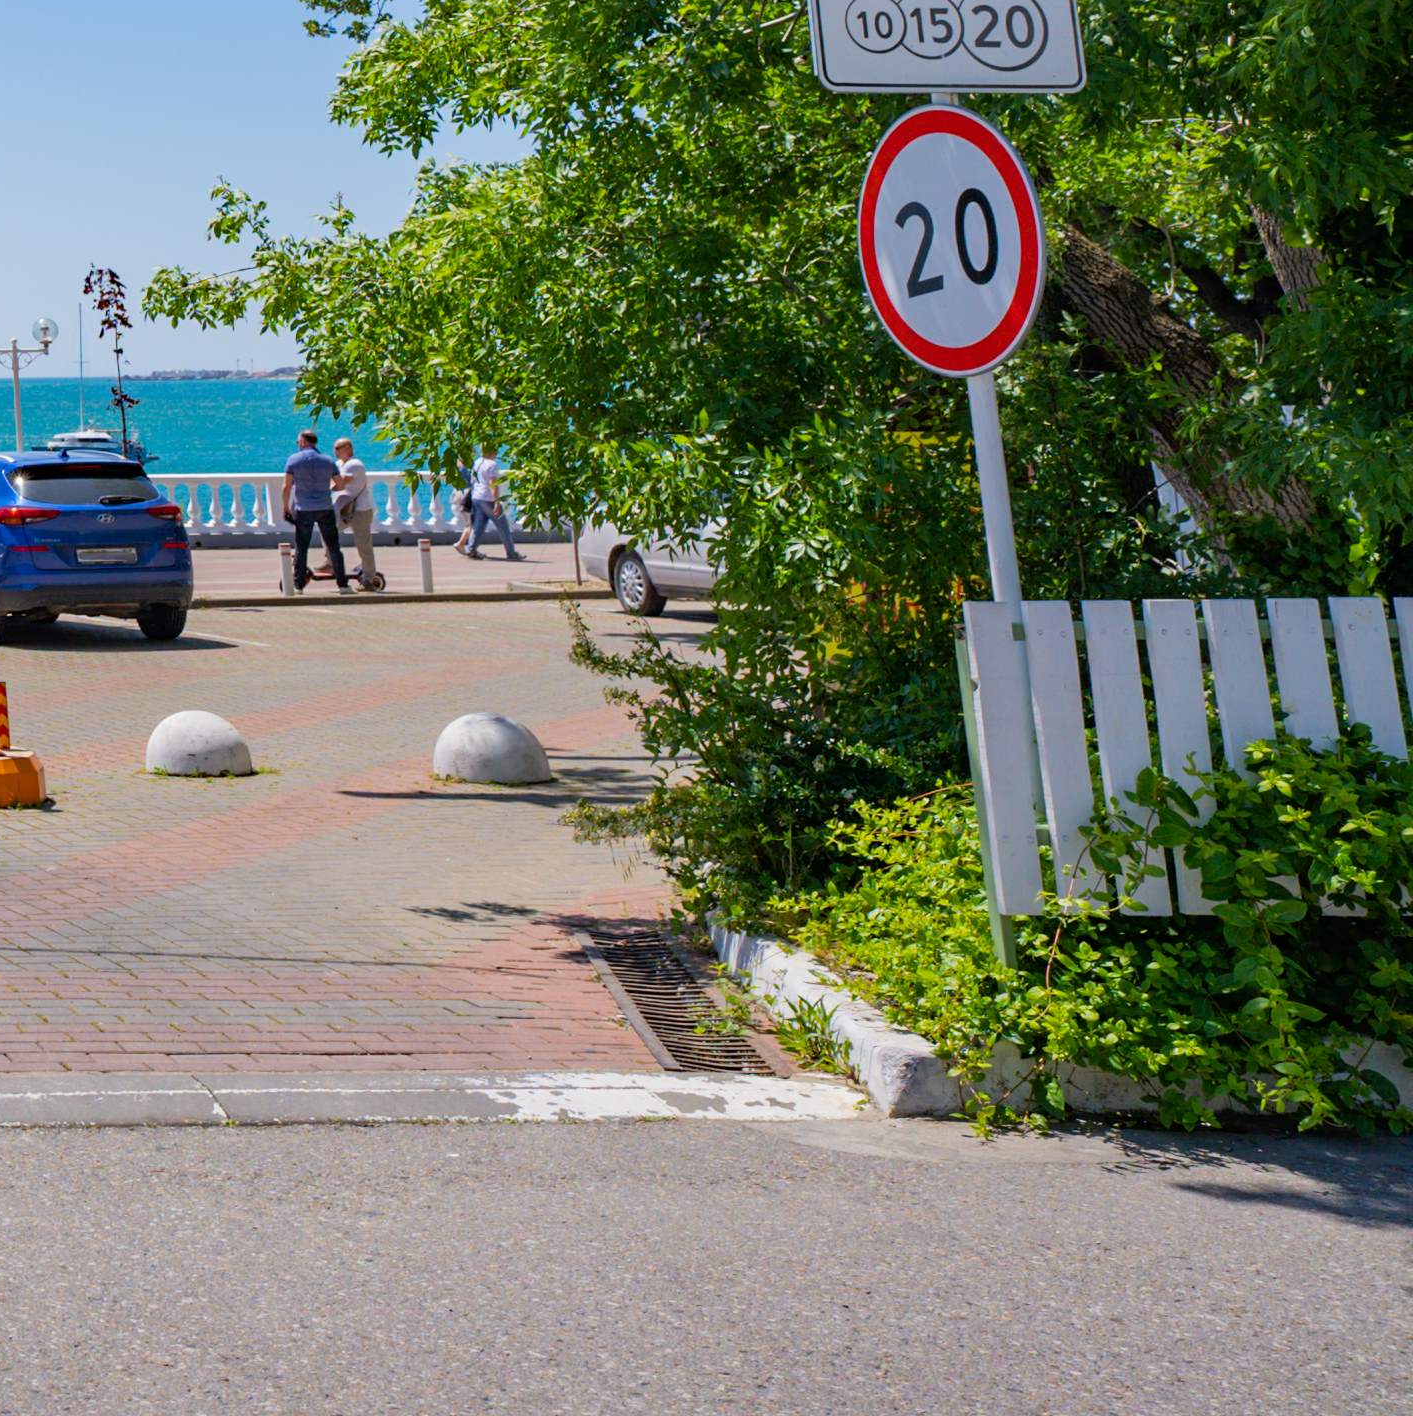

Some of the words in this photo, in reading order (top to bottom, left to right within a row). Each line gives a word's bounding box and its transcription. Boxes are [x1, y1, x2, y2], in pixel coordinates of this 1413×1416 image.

[856, 11, 893, 39] 10
[910, 7, 953, 44] 15
[971, 4, 1035, 49] 20
[894, 187, 999, 298] 20
